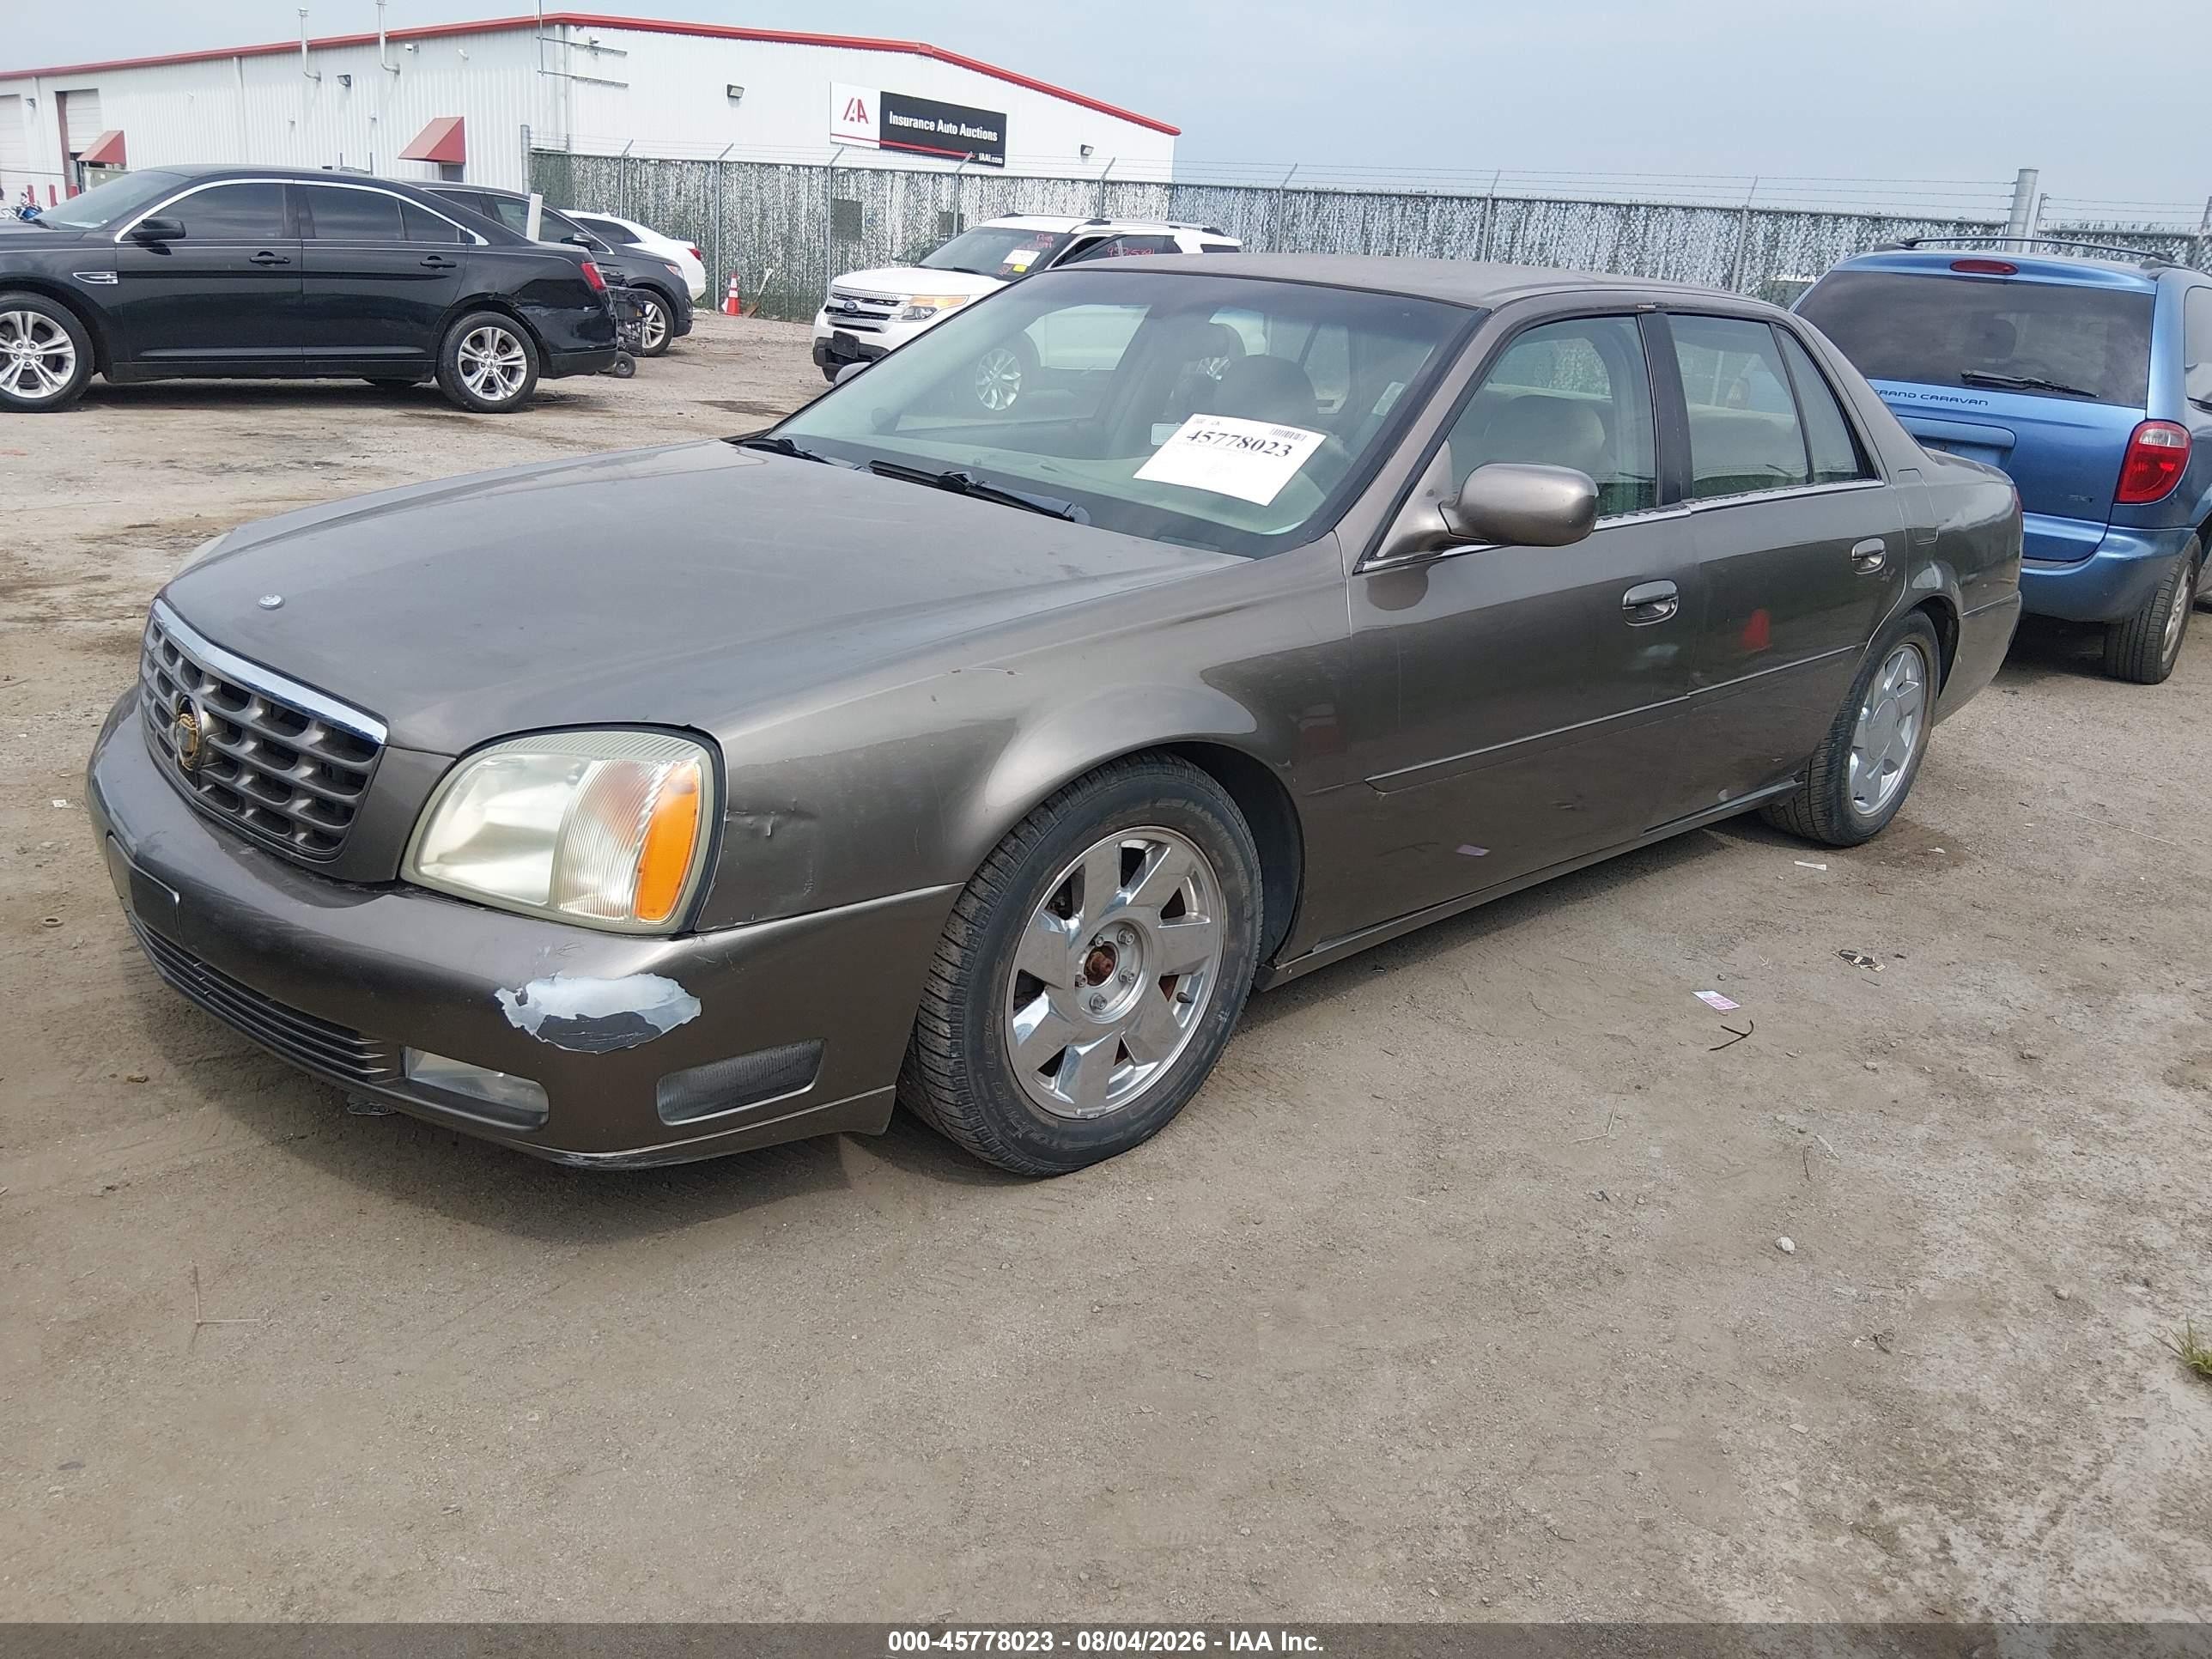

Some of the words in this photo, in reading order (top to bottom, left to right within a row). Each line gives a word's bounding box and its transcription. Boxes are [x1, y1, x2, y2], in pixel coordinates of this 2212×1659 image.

[889, 111, 935, 131] Insurance
[937, 119, 958, 135] Auto
[959, 123, 999, 143] Auctions
[979, 152, 1003, 164] IAAI.com
[1920, 393, 1989, 406] CARAVAN
[1186, 429, 1293, 457] 45778023
